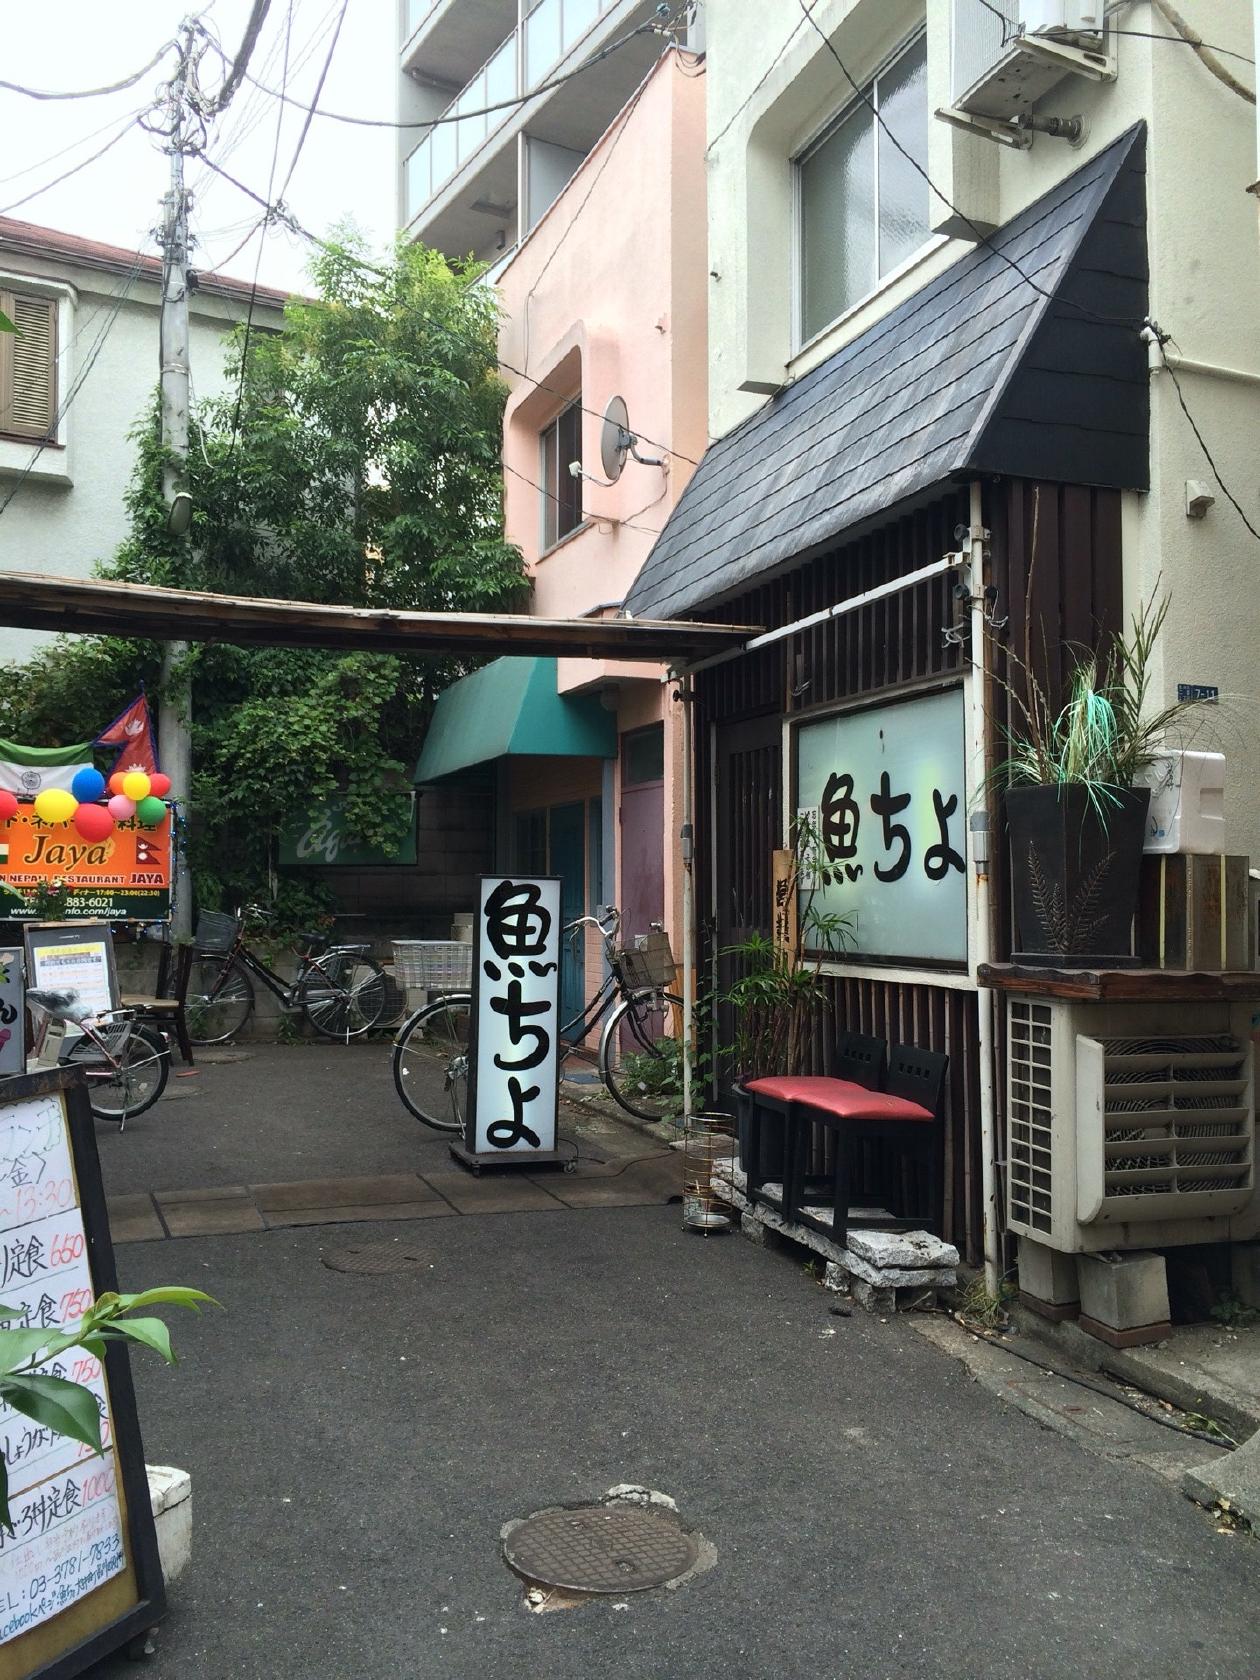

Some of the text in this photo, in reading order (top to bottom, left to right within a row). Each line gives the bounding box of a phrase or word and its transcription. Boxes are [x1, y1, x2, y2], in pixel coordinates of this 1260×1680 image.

[24, 835, 108, 871] Jaya
[131, 873, 164, 884] JAYA
[50, 1234, 84, 1267] 650
[60, 1289, 92, 1322] 750
